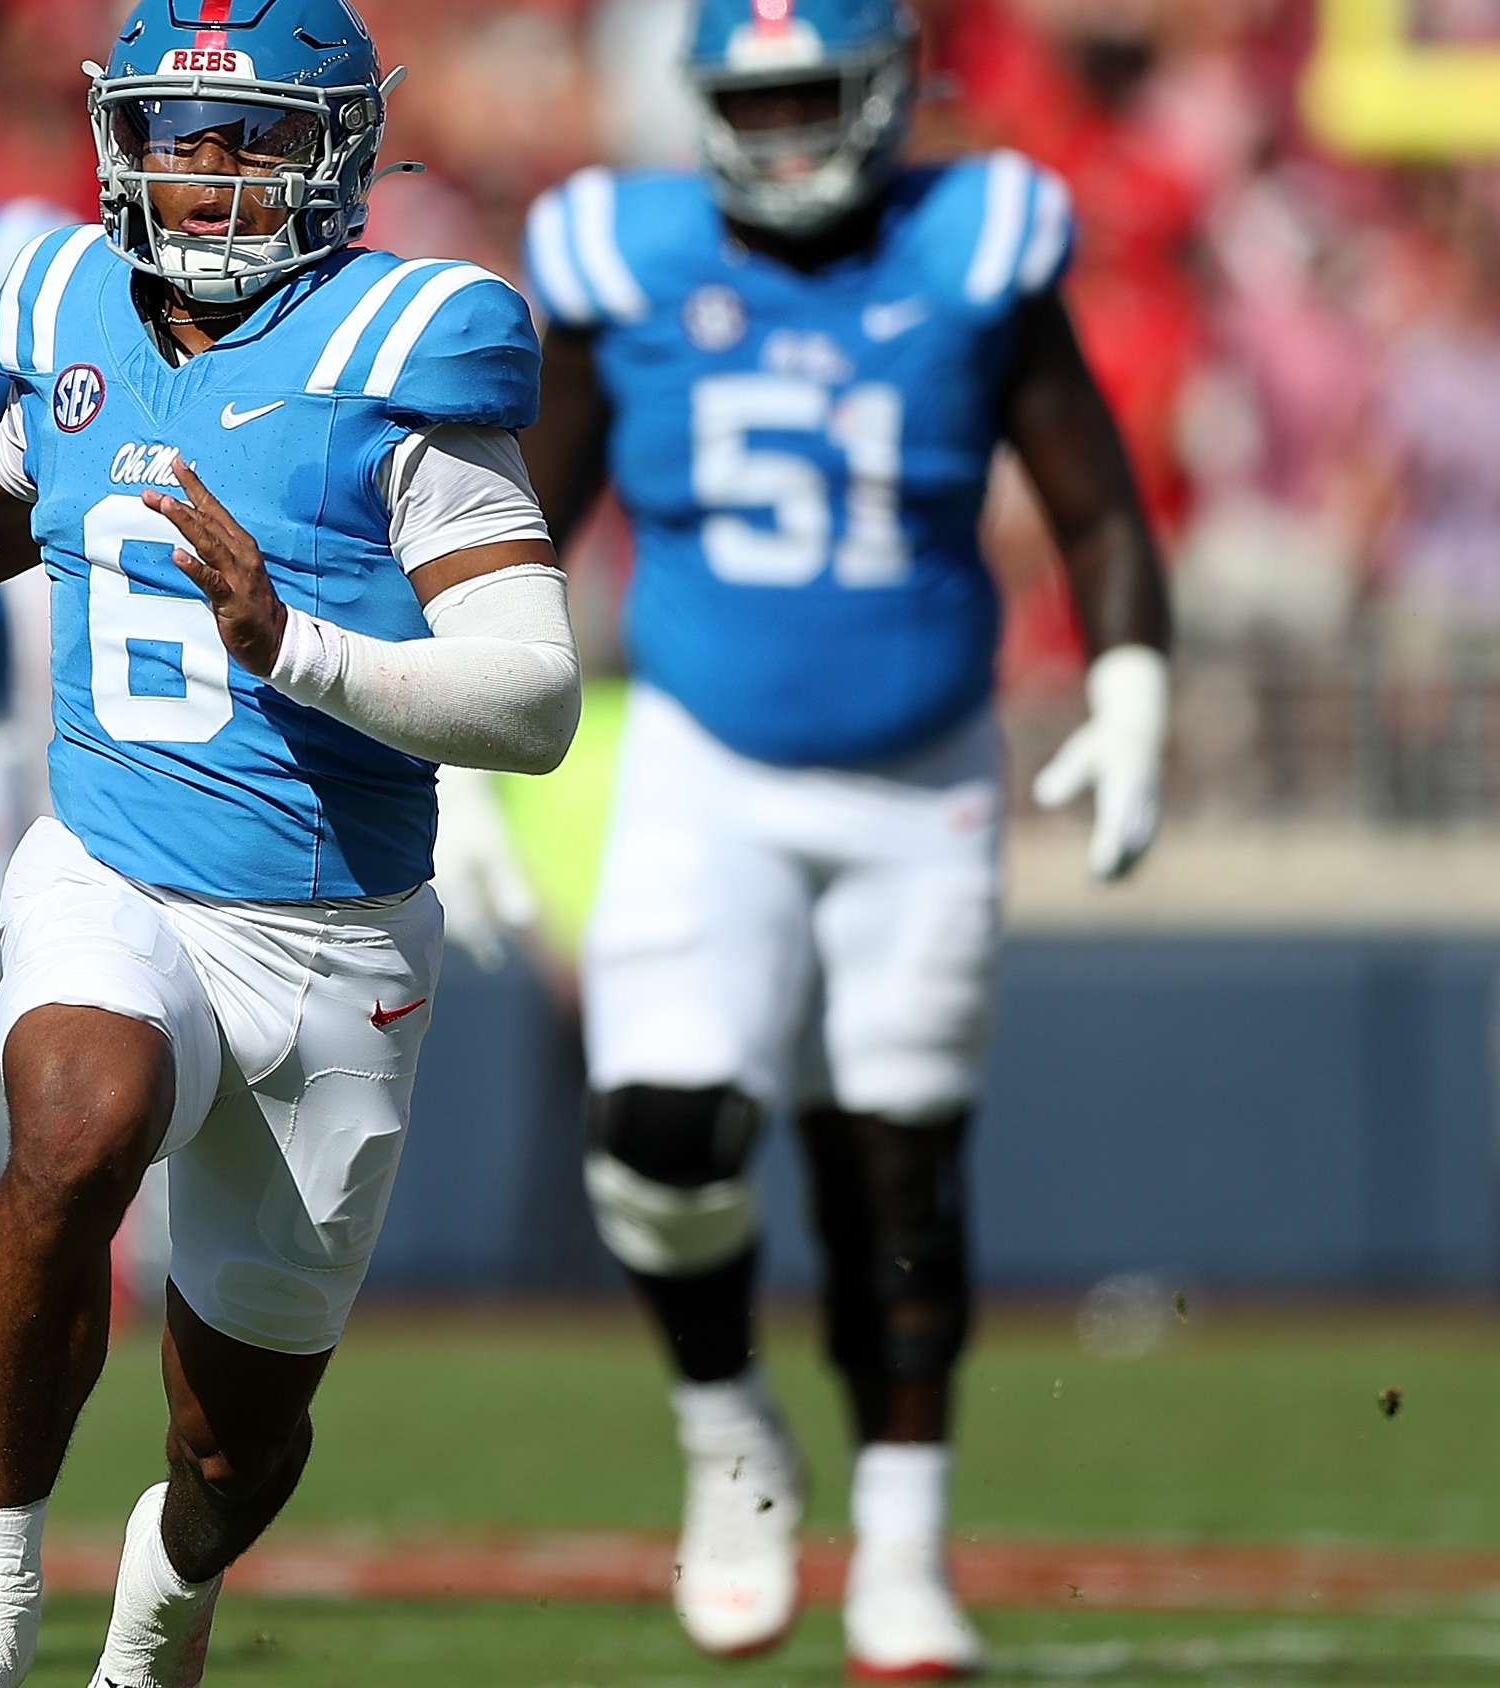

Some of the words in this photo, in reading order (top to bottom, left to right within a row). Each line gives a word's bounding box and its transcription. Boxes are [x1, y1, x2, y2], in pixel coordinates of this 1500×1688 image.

[172, 51, 237, 72] REBS
[56, 368, 101, 427] SEC
[110, 442, 146, 484] Ole
[692, 373, 911, 587] 51
[84, 493, 235, 743] 6
